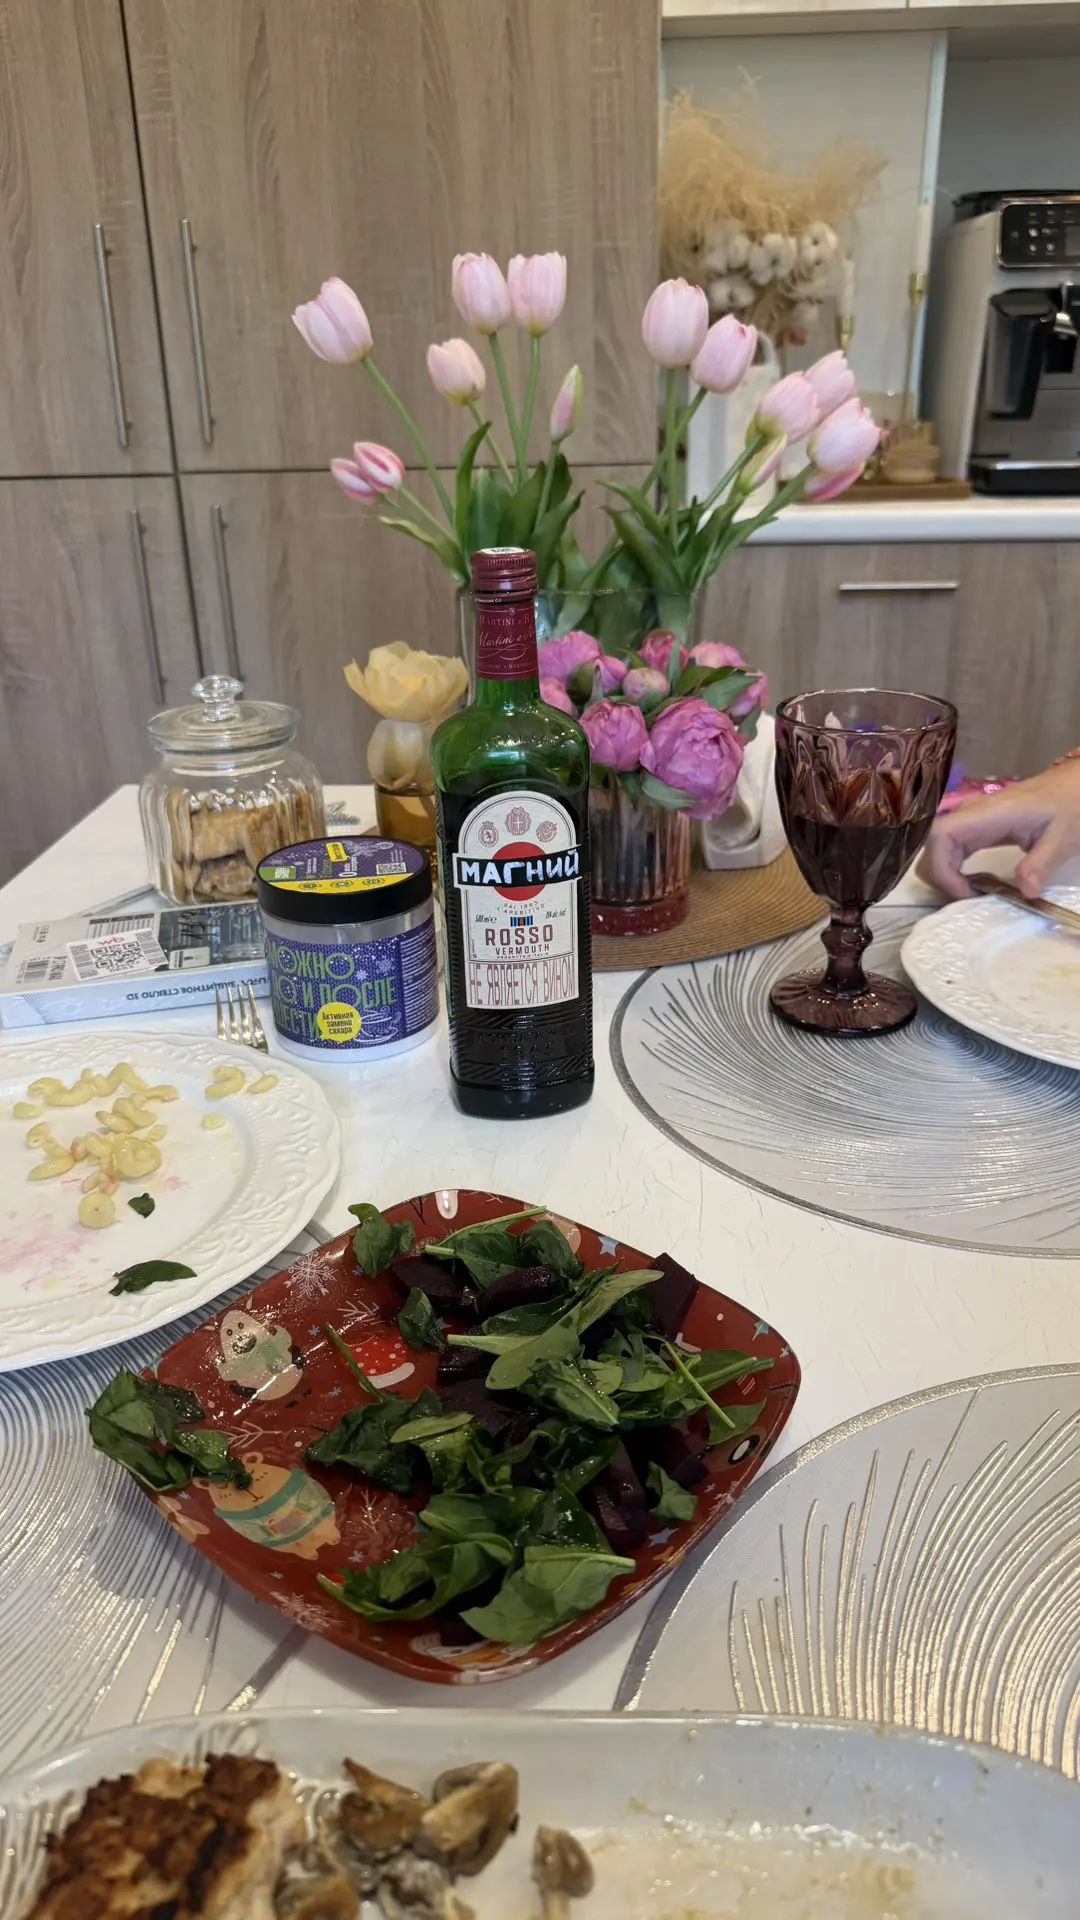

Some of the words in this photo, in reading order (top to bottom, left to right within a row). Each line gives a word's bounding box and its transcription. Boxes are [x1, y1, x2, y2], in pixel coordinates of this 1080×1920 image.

[479, 614, 515, 626] MARTINI
[478, 631, 515, 647] Martini
[460, 848, 580, 885] МАГНИЙ
[503, 902, 517, 910] DAL
[485, 924, 554, 946] ROSSO
[495, 945, 550, 956] VERMOUTH
[469, 963, 482, 1005] НЕ
[487, 962, 539, 1006] ЯВЛЯЕТСЯ
[543, 954, 576, 1003] ВИНОМ
[140, 987, 180, 999] СТЕКЛО
[181, 980, 237, 995] ЗАЩИТНОЕ
[303, 979, 315, 1009] И
[319, 976, 397, 1009] ПОСЛЕ
[126, 992, 140, 1001] 3D
[322, 1011, 354, 1021] Активная
[326, 1020, 352, 1028] замена
[328, 1027, 353, 1035] сахара
